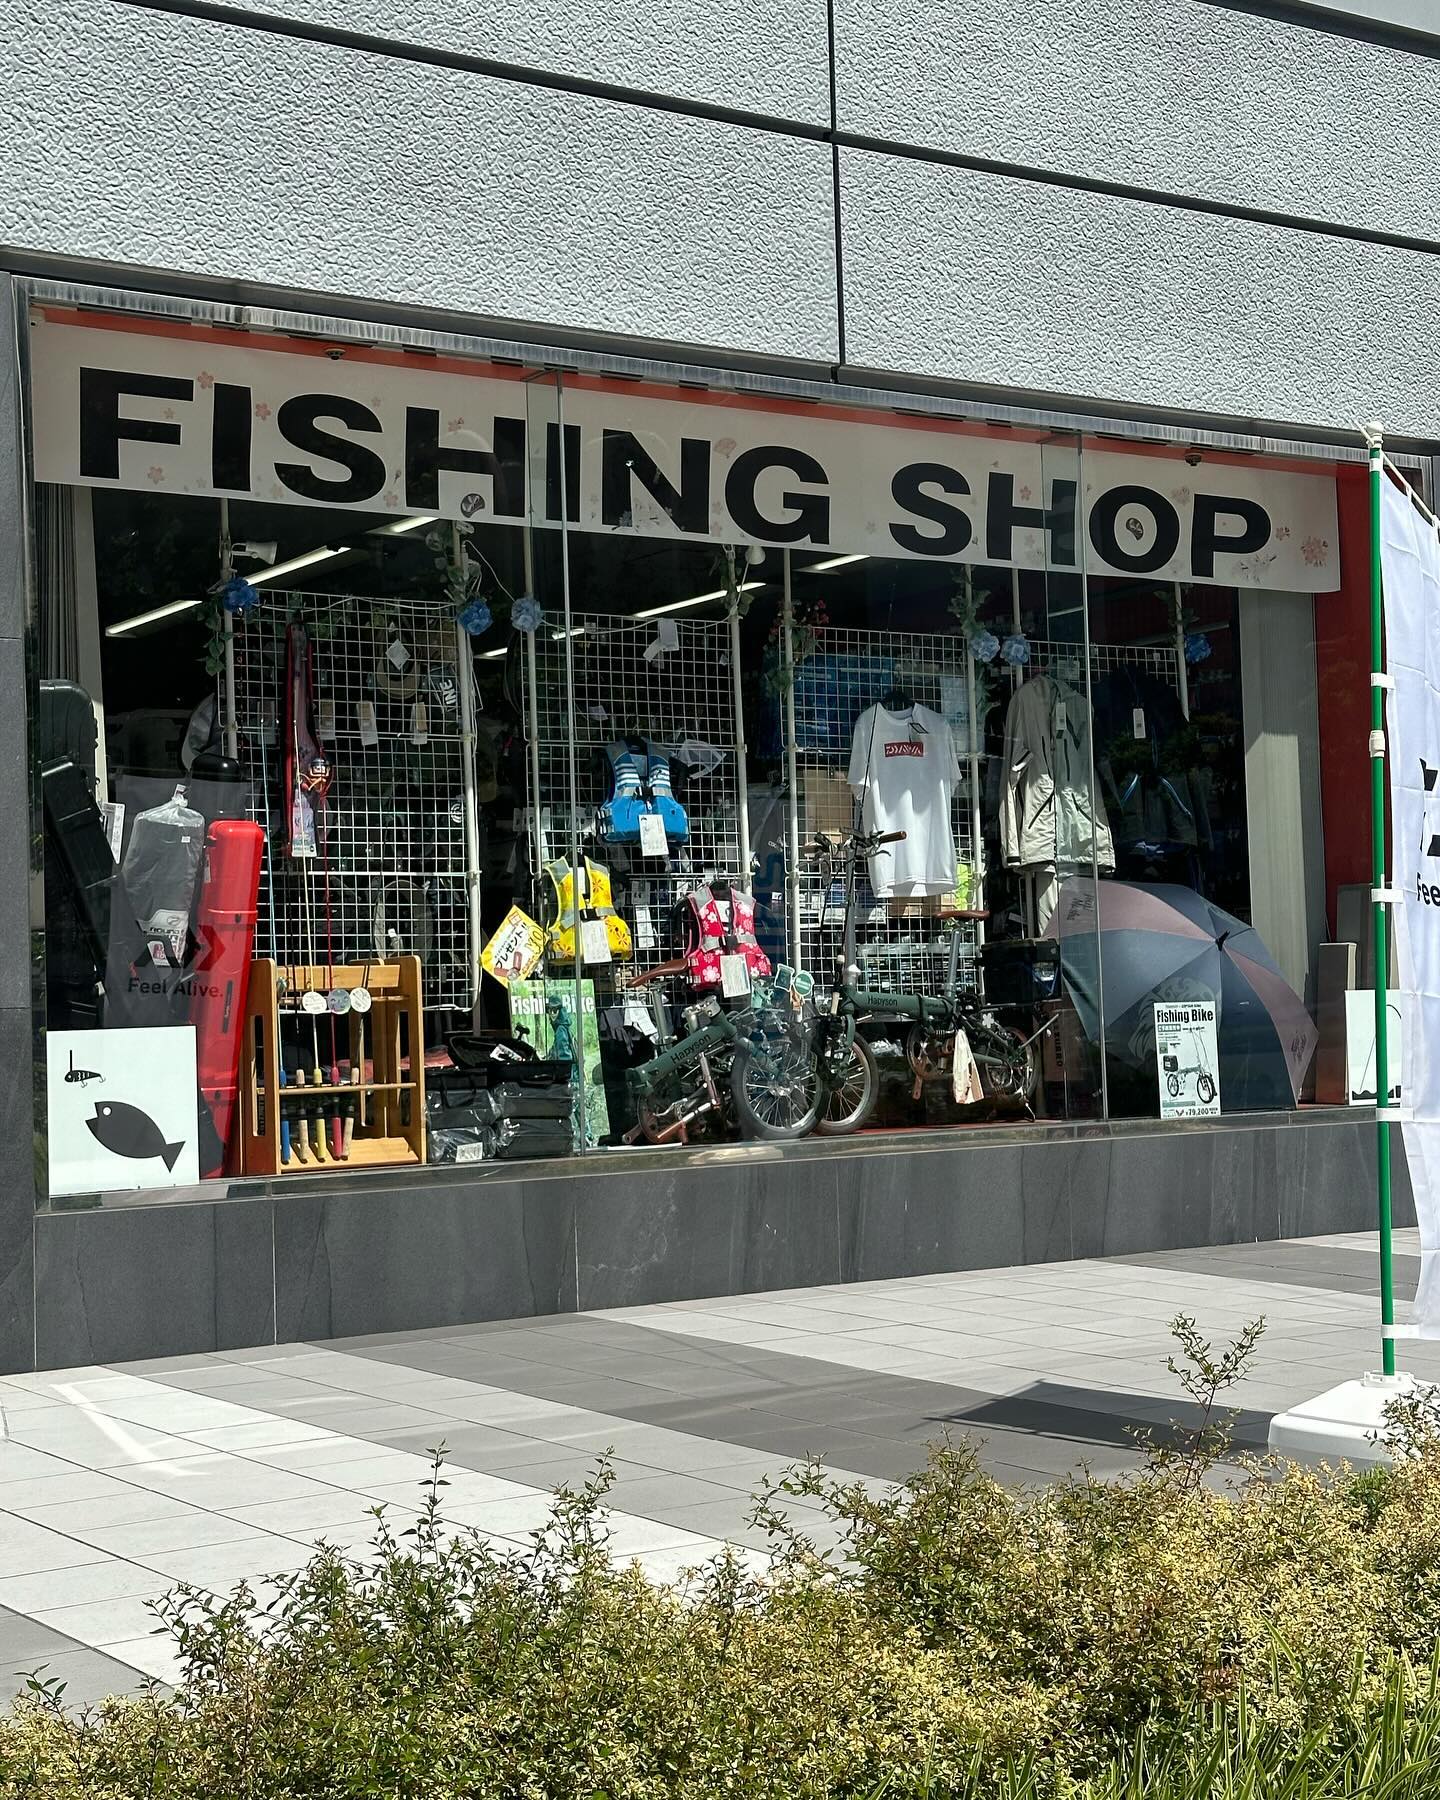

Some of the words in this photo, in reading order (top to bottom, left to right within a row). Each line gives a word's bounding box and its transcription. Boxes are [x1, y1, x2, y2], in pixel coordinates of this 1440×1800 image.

[80, 367, 830, 545] FISHING
[889, 462, 1272, 578] SHOP
[128, 977, 167, 994] Feel
[172, 980, 223, 998] Alive.
[1157, 1009, 1190, 1024] Fishing
[1191, 1009, 1214, 1022] Bike
